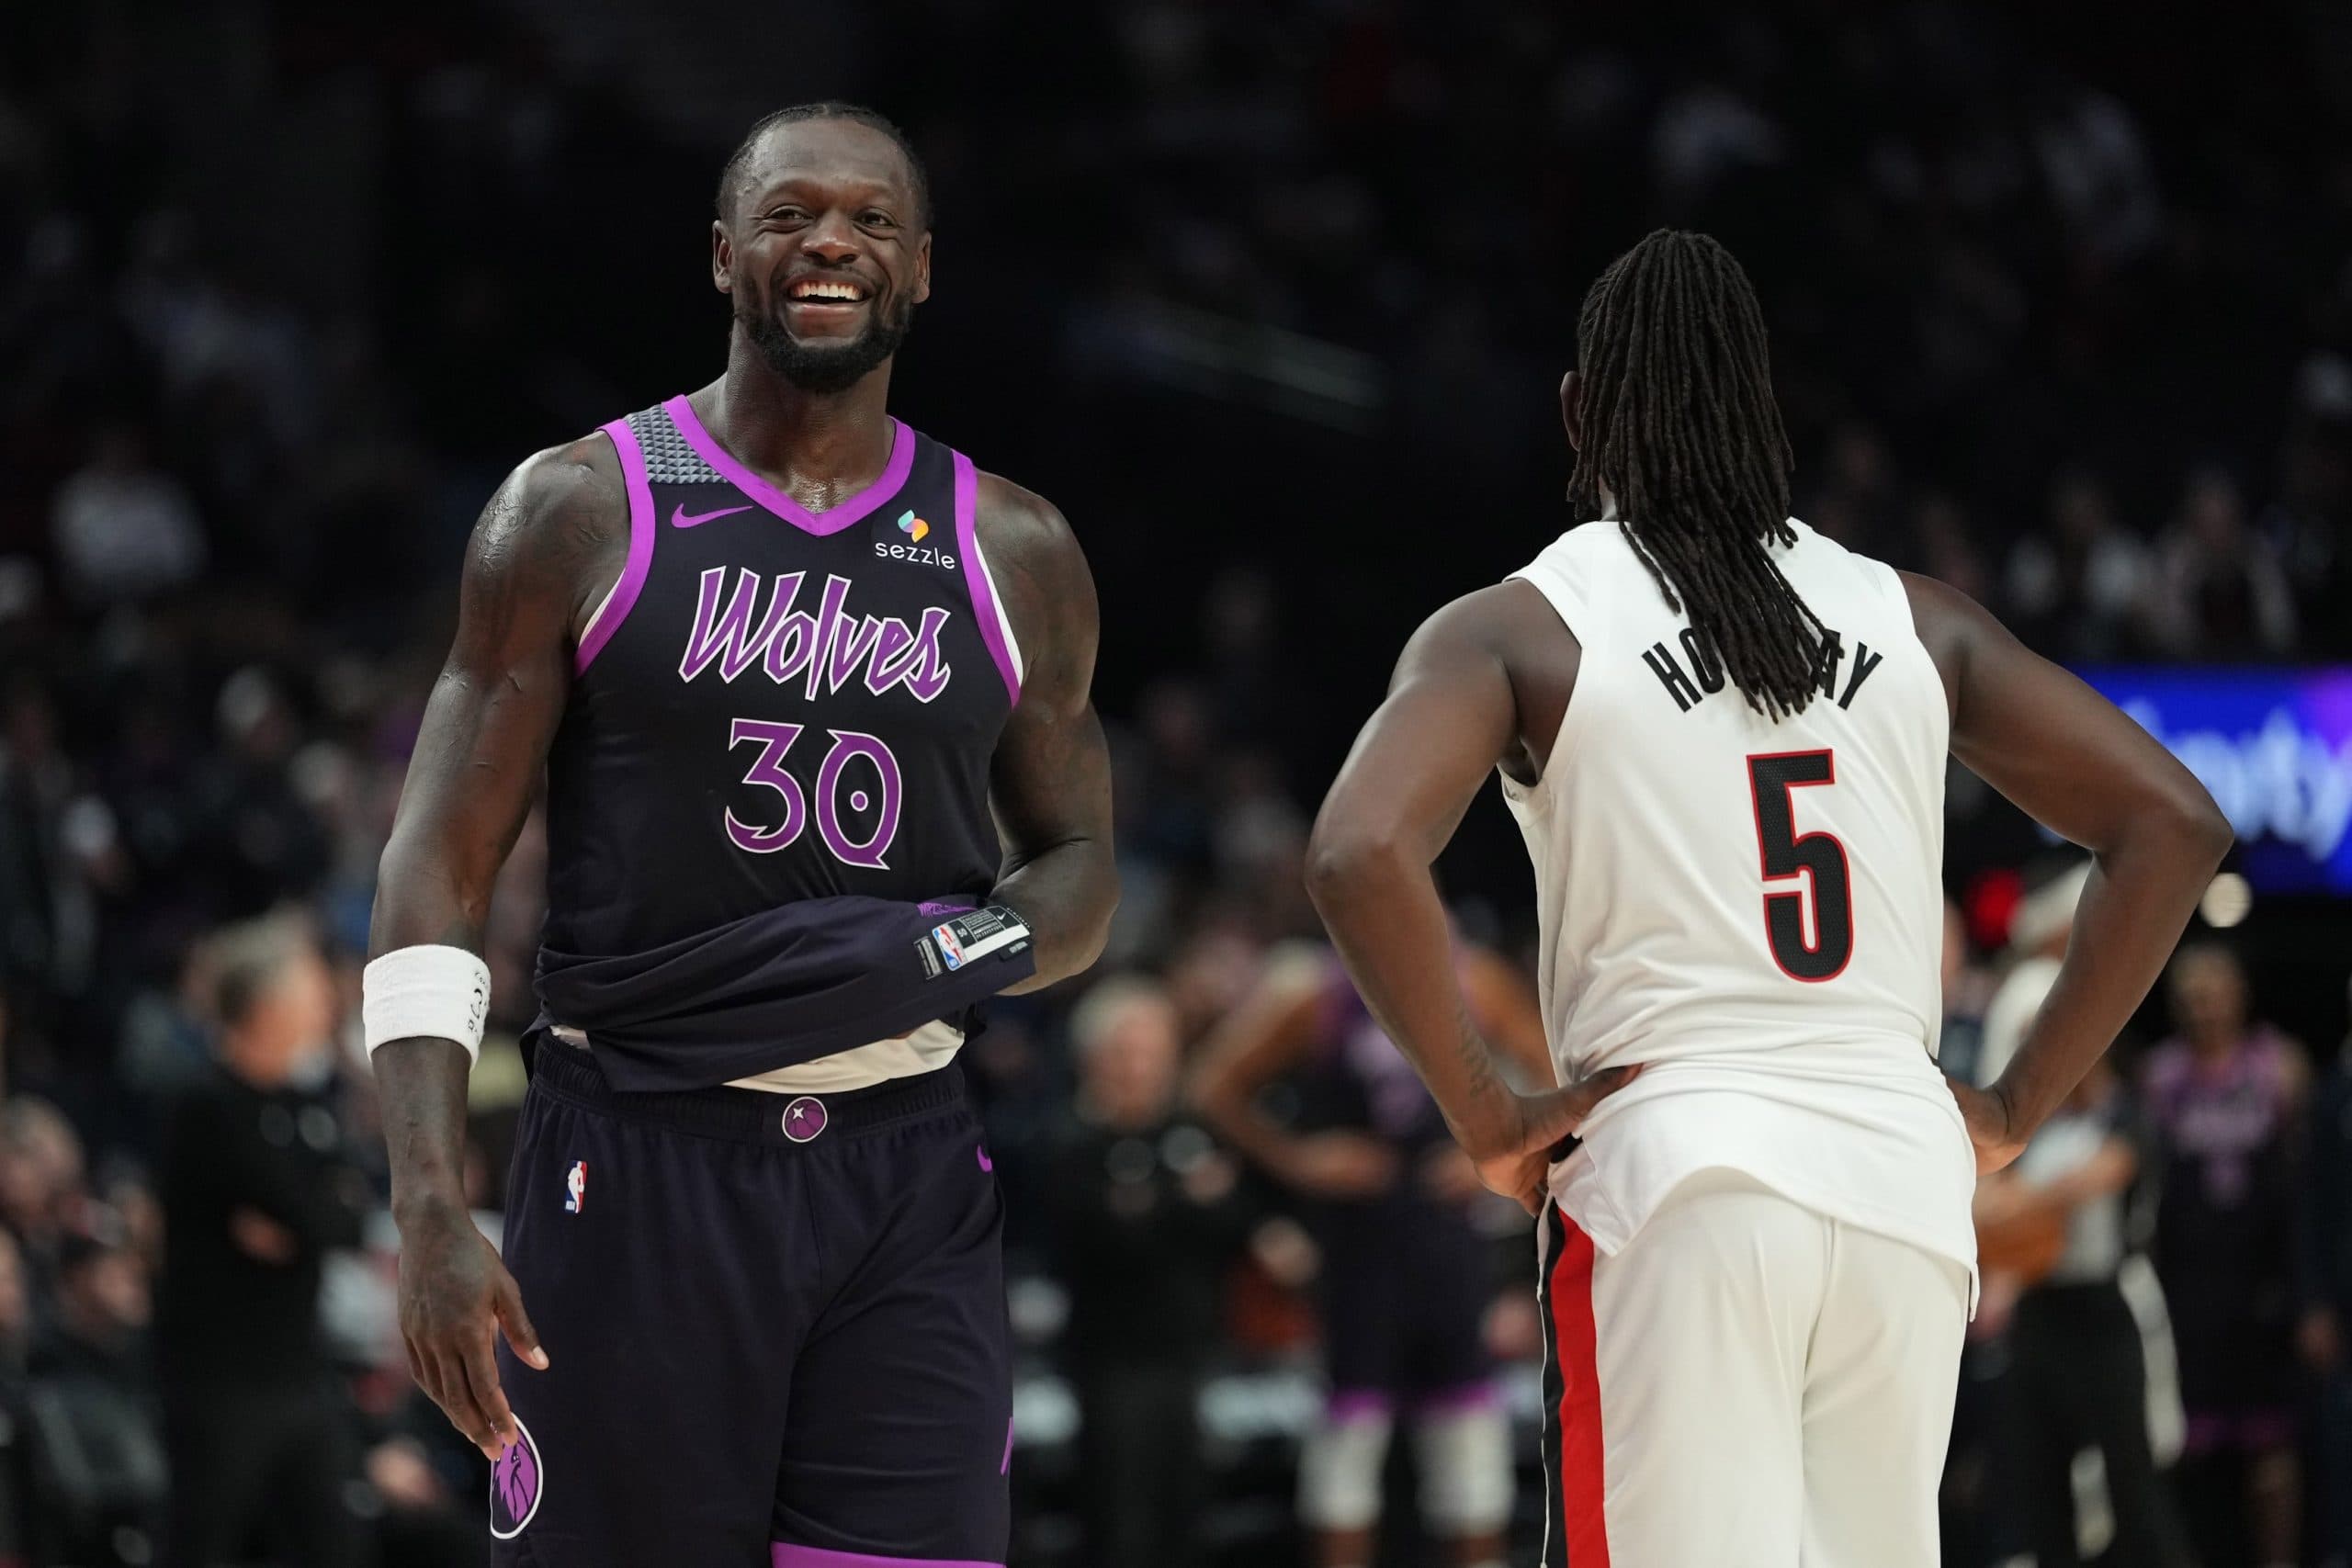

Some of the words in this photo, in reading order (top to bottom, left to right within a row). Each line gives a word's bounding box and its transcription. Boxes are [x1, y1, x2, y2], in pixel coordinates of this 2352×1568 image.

[875, 540, 956, 570] sezzle
[678, 565, 952, 704] Wolves
[1640, 626, 1883, 714] HOAY
[724, 717, 902, 870] 30
[1746, 748, 1854, 984] 5
